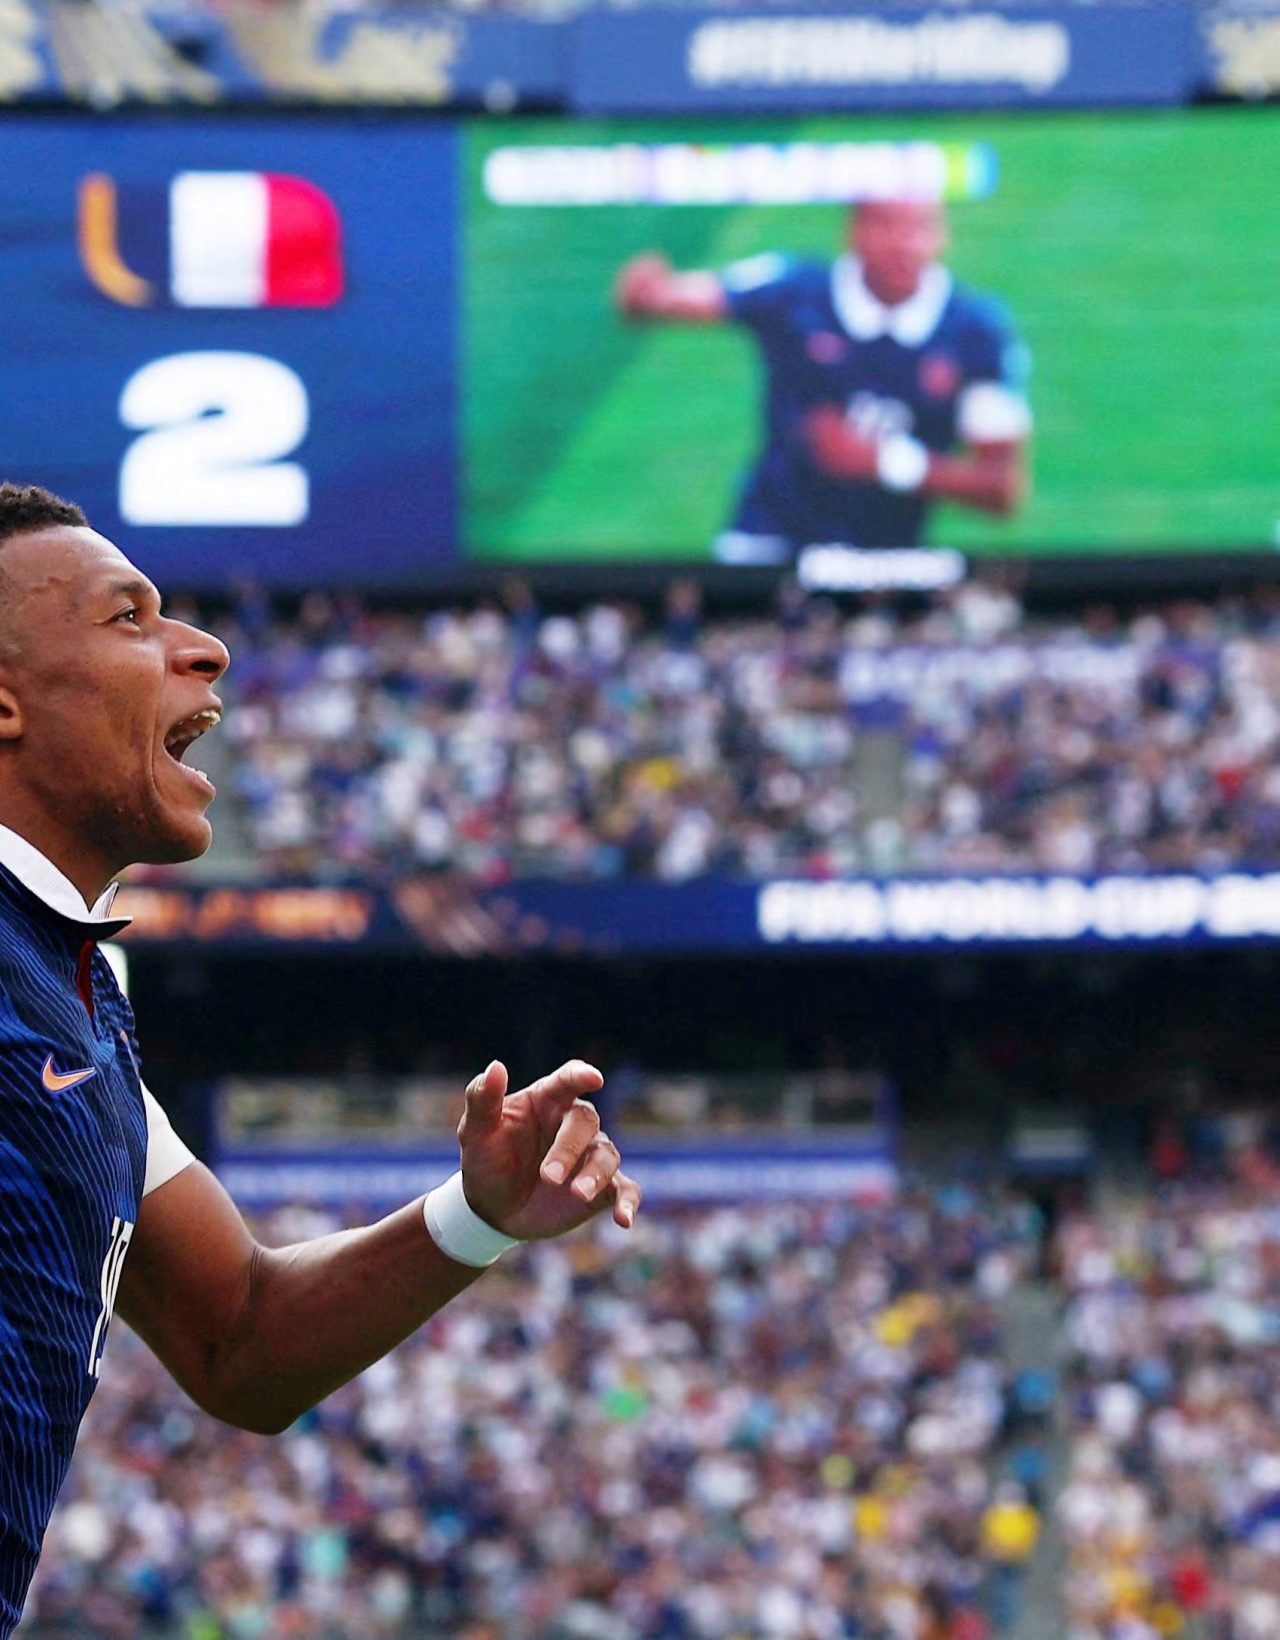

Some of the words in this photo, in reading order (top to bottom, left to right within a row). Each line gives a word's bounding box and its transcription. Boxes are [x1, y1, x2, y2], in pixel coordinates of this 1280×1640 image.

[119, 350, 308, 527] 2
[889, 877, 1087, 940] WORLD
[1092, 876, 1198, 938] CUP
